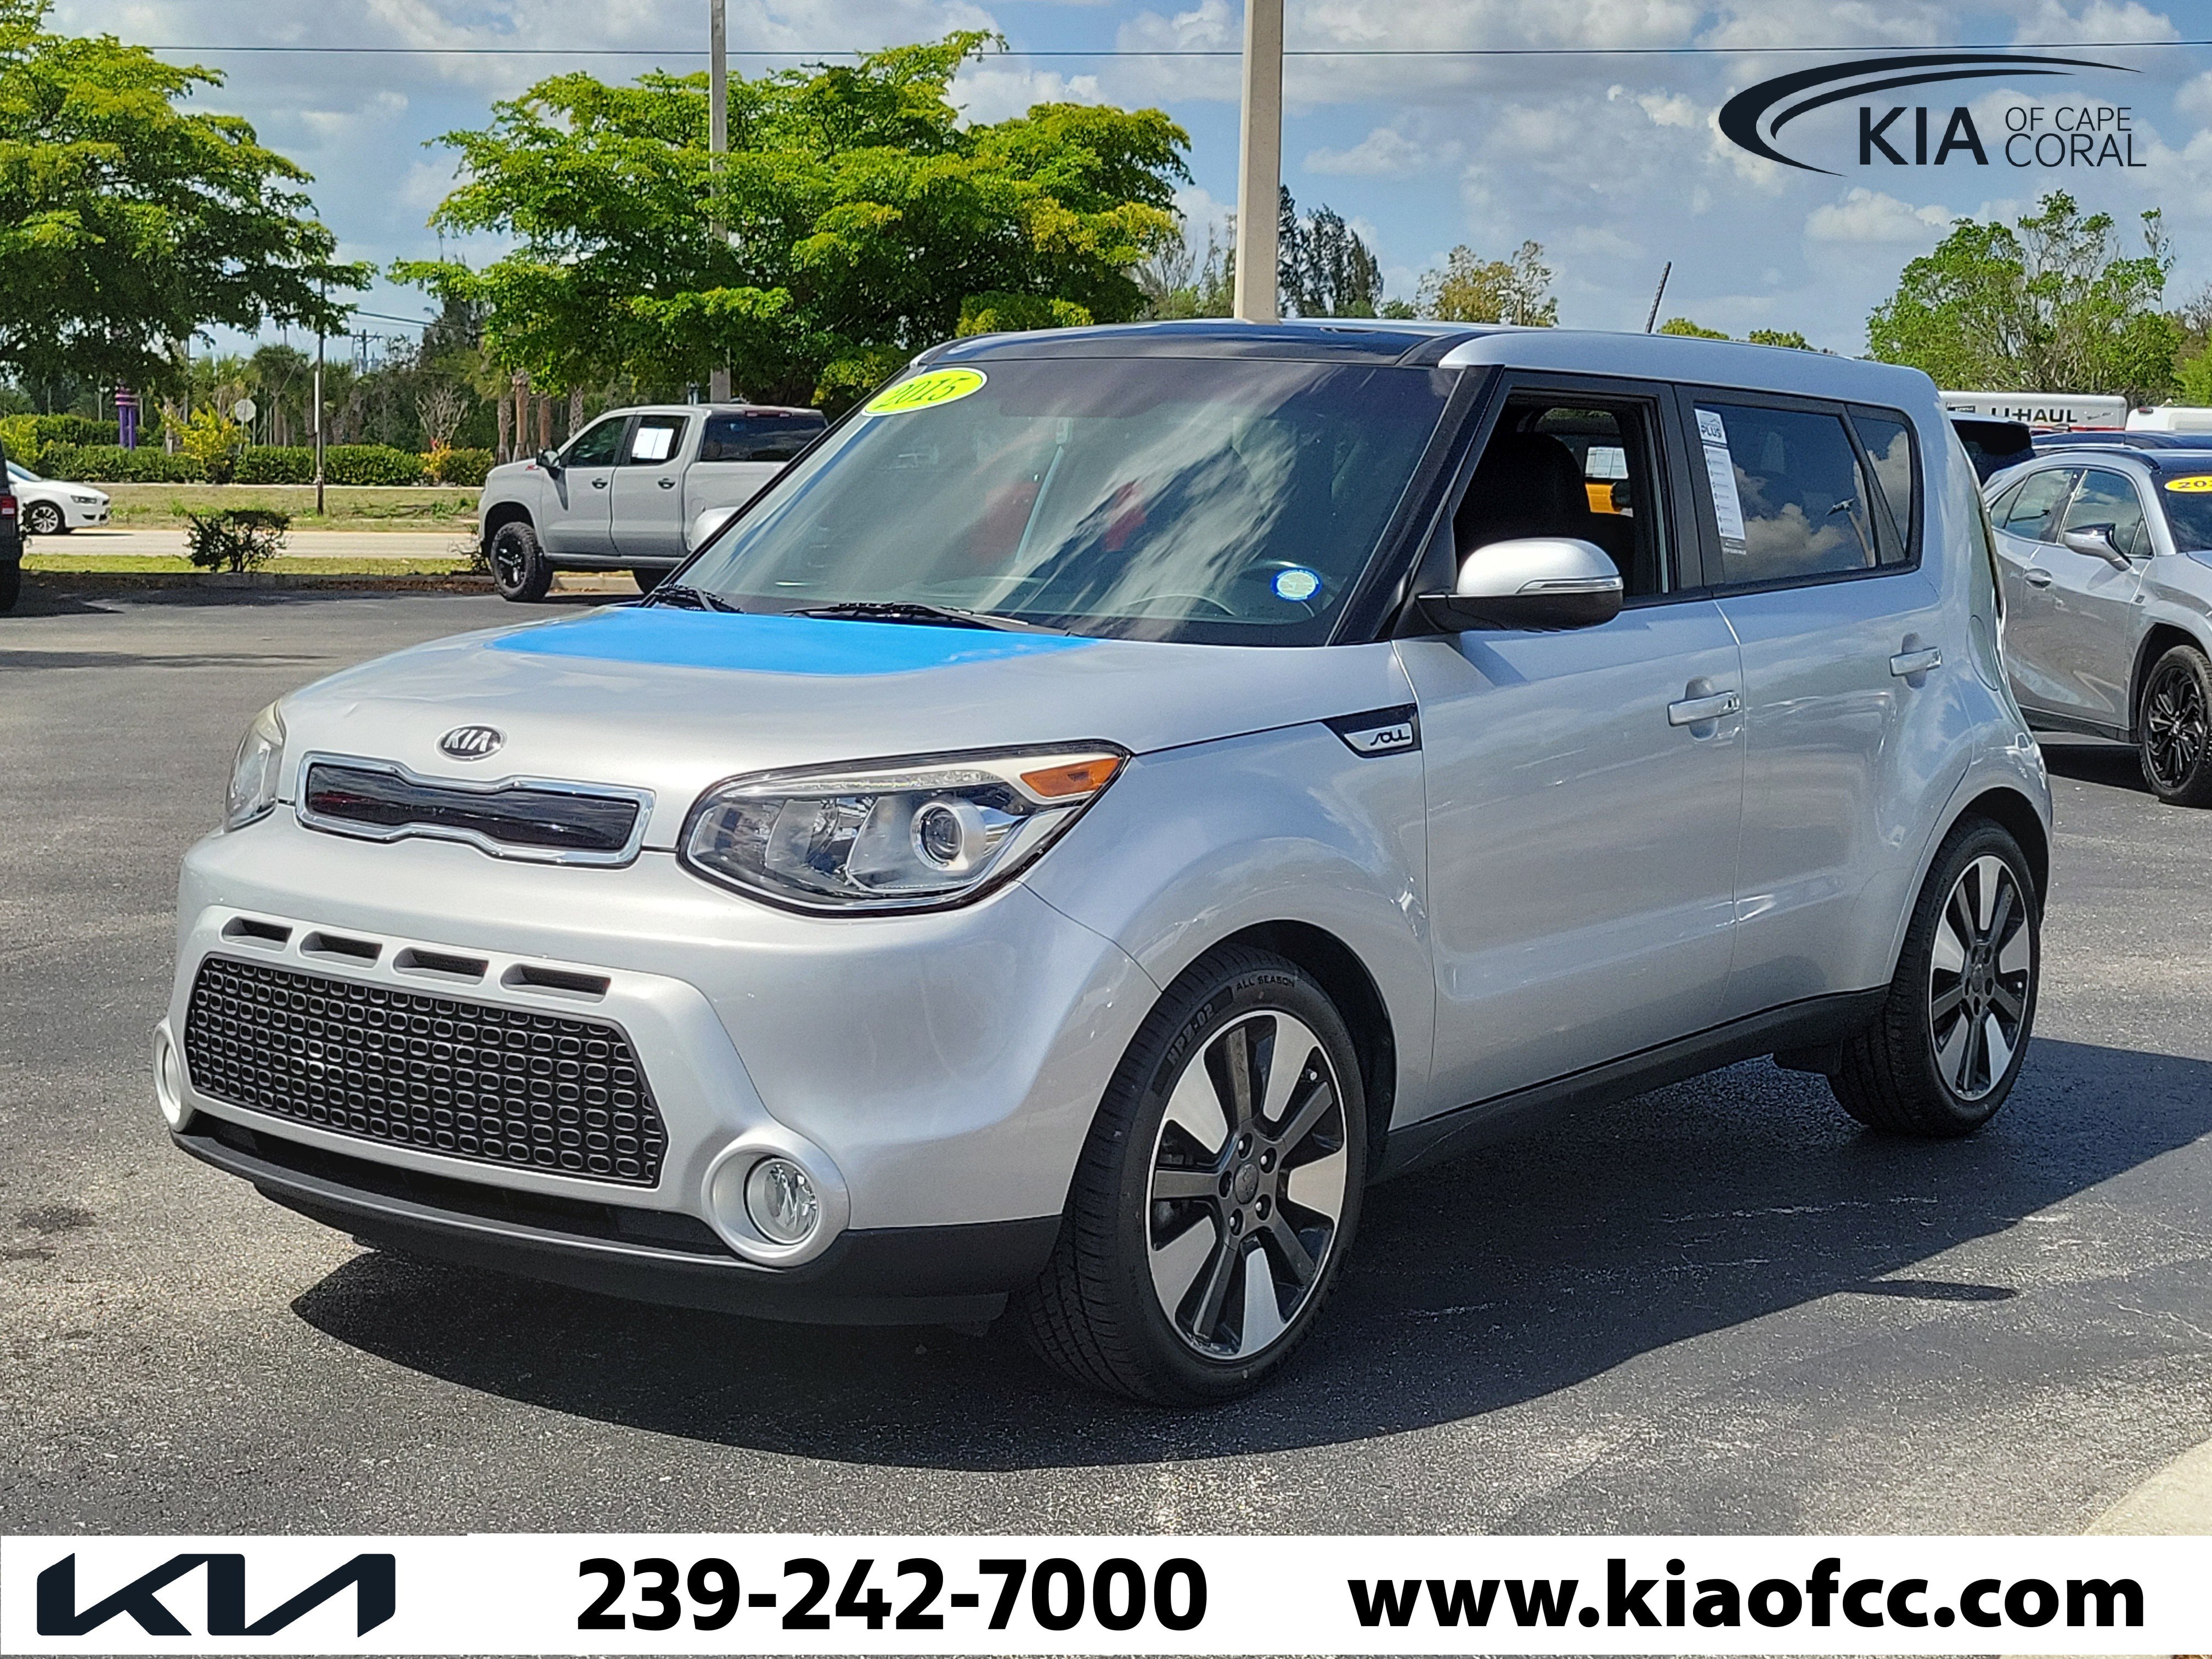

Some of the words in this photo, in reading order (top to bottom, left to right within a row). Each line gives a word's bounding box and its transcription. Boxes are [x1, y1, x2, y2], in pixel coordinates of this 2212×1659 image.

[874, 377, 971, 410] 2015
[444, 729, 492, 752] KIA
[1237, 979, 1255, 991] ALL
[1257, 975, 1295, 988] SEASON
